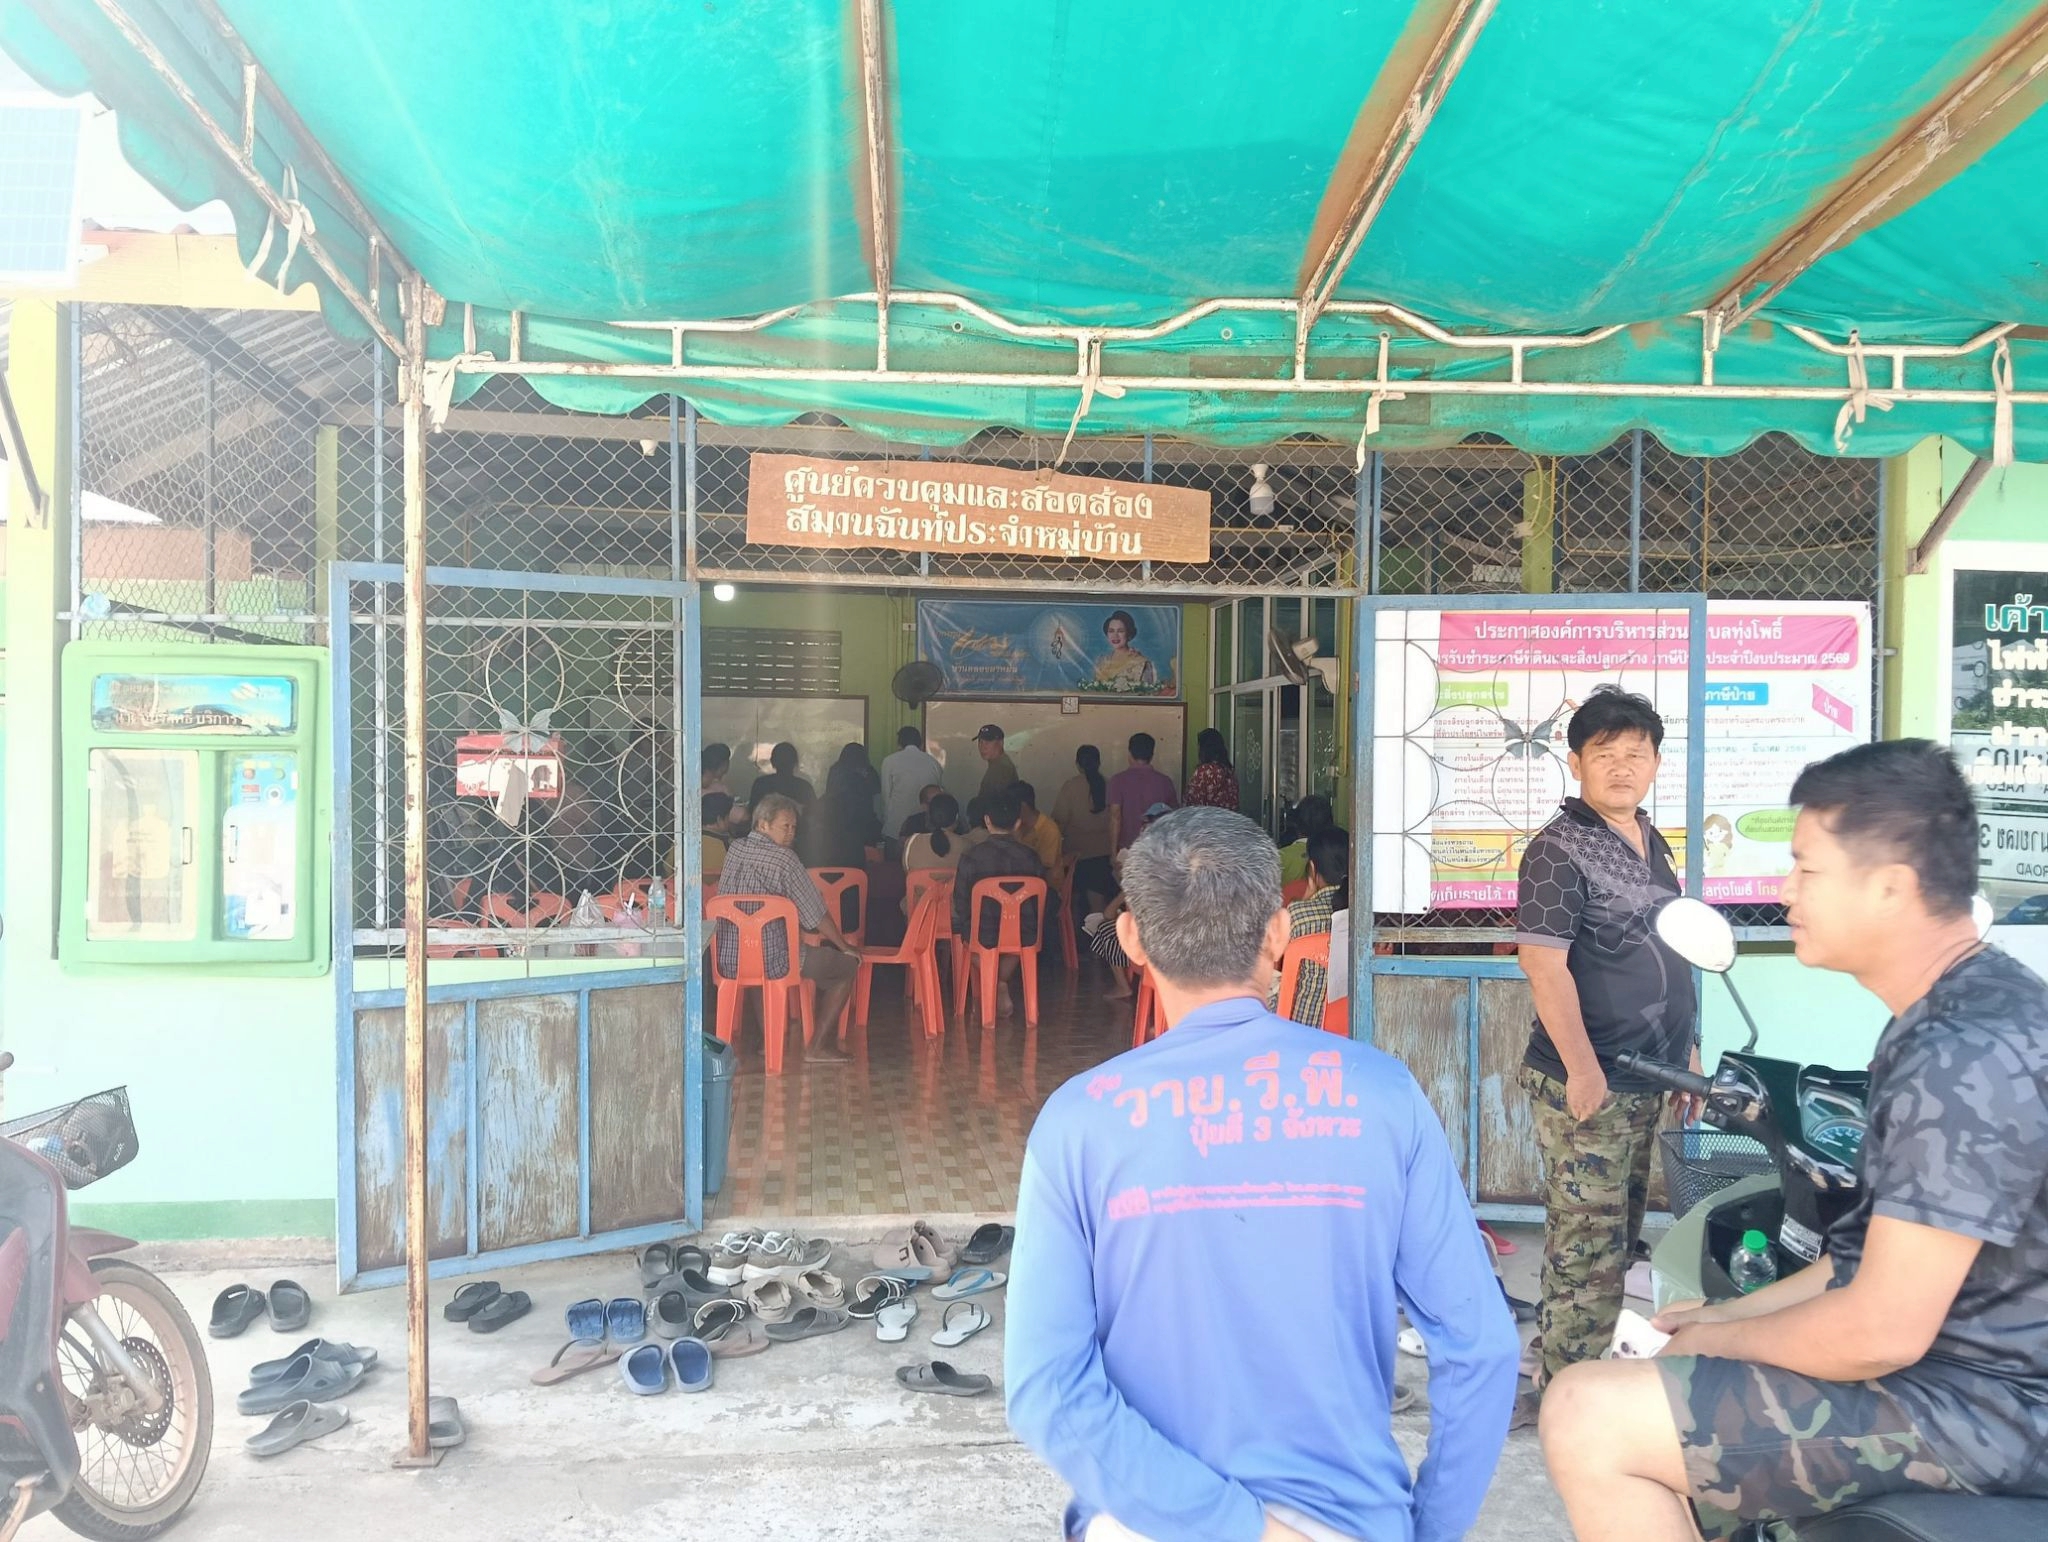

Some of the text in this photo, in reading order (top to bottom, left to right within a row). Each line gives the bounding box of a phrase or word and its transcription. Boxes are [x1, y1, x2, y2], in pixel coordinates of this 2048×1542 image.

[784, 465, 1153, 520] ศูนย์ควบคุมและสอดส่อง
[786, 503, 1143, 557] สมานฉันท์ประจำหมู่บ้าน
[1113, 1051, 1359, 1128] วาย.วี.พี.
[1254, 1115, 1272, 1142] 3
